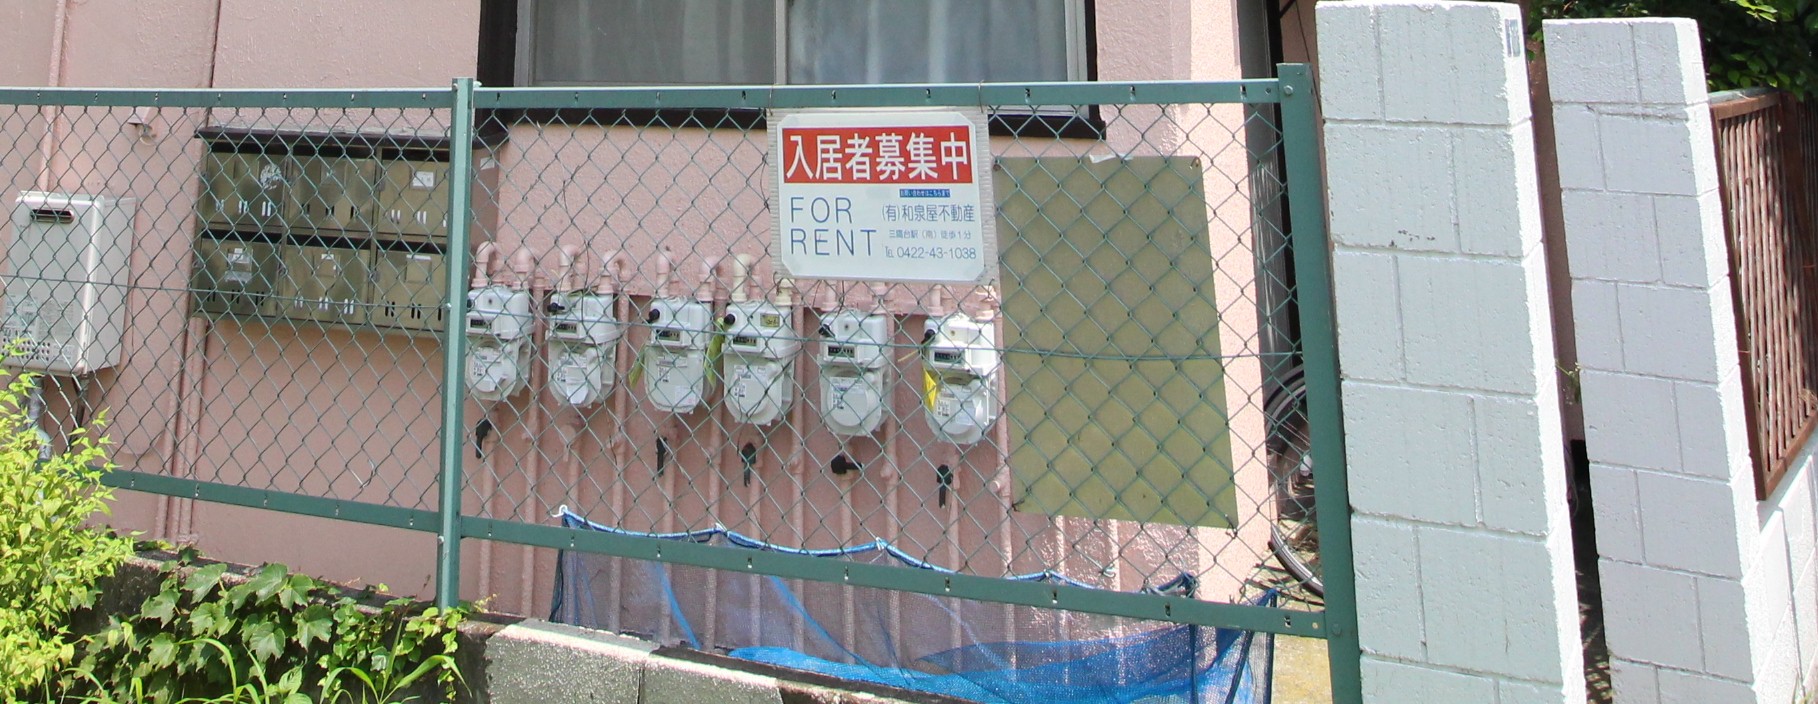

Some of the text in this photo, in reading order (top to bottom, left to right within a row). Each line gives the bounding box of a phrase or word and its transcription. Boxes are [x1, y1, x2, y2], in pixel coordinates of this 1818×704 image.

[786, 132, 968, 181] 入居者募集中
[790, 197, 853, 224] FOR
[882, 204, 975, 222] (有)和泉屋不動産
[790, 229, 877, 256] RENT
[896, 247, 977, 260] 0422-43-1038
